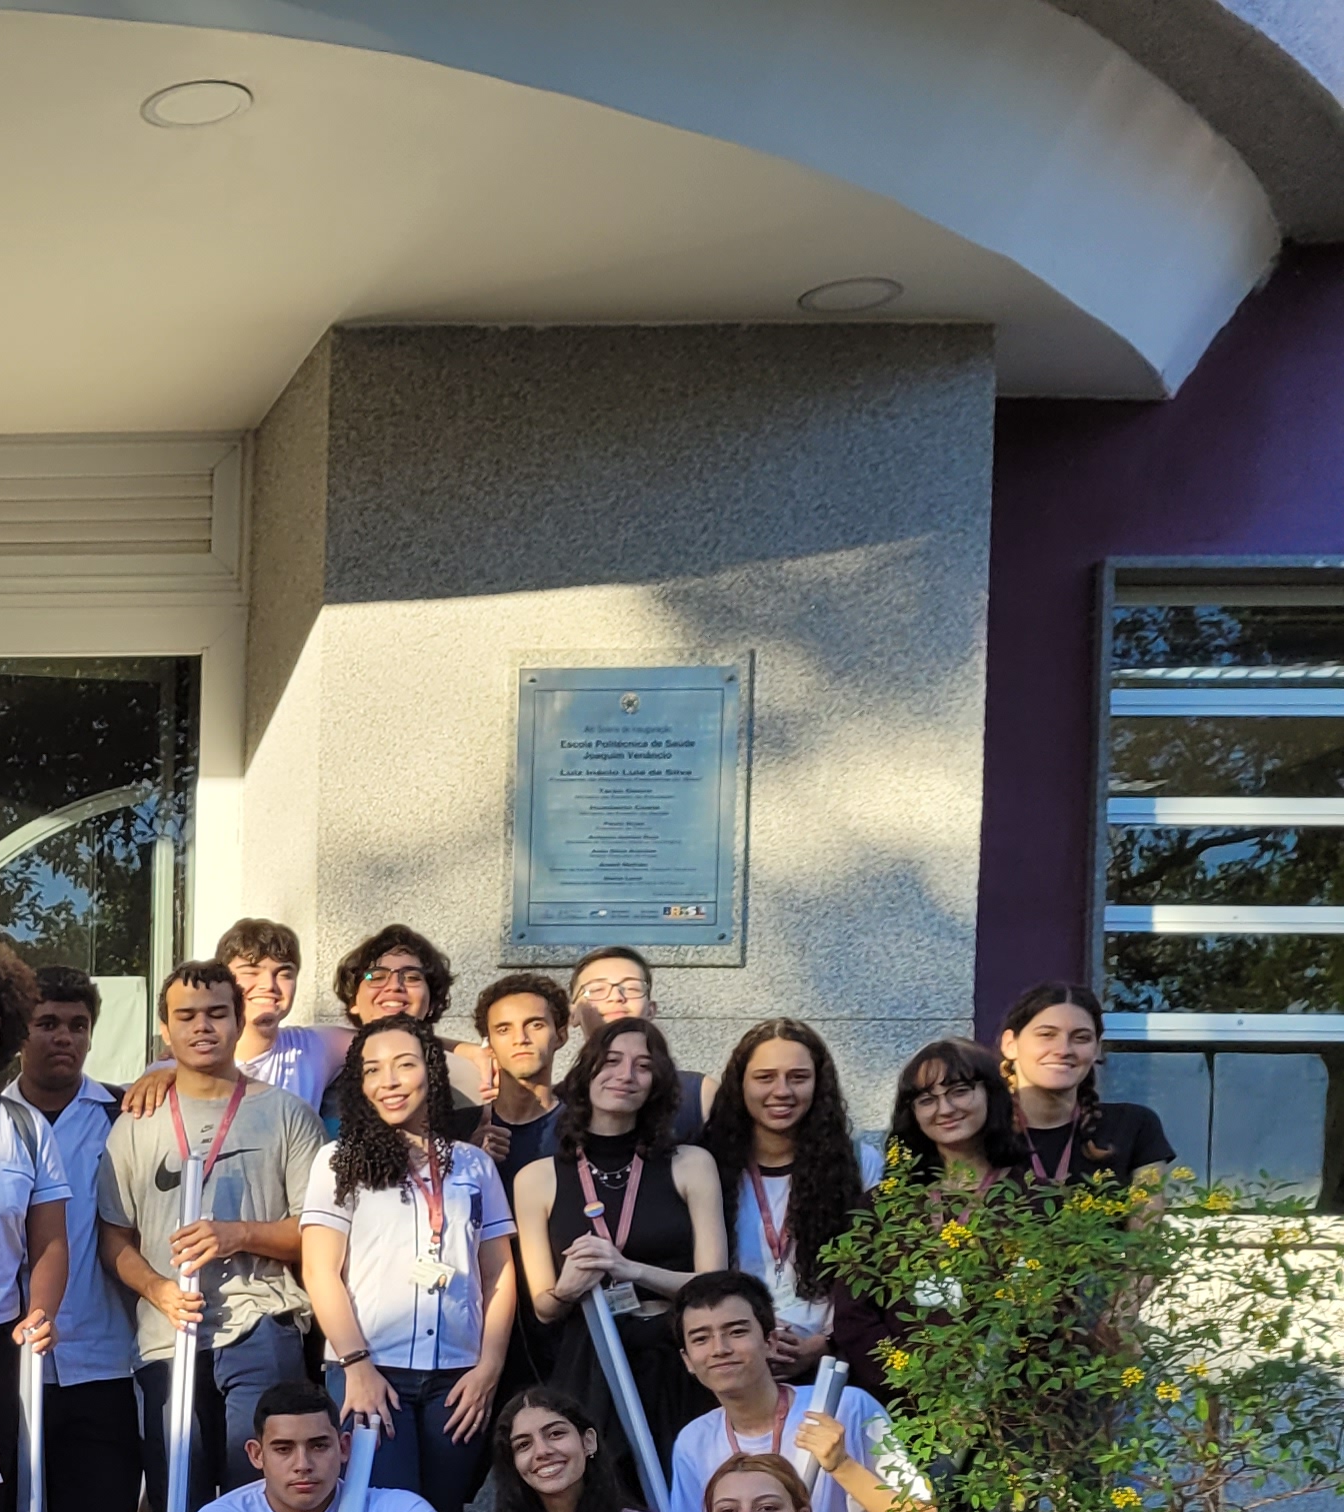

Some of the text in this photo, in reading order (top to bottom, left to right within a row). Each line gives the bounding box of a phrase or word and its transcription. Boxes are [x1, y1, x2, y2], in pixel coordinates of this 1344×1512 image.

[560, 739, 696, 749] Escola Politécnica de Saúde
